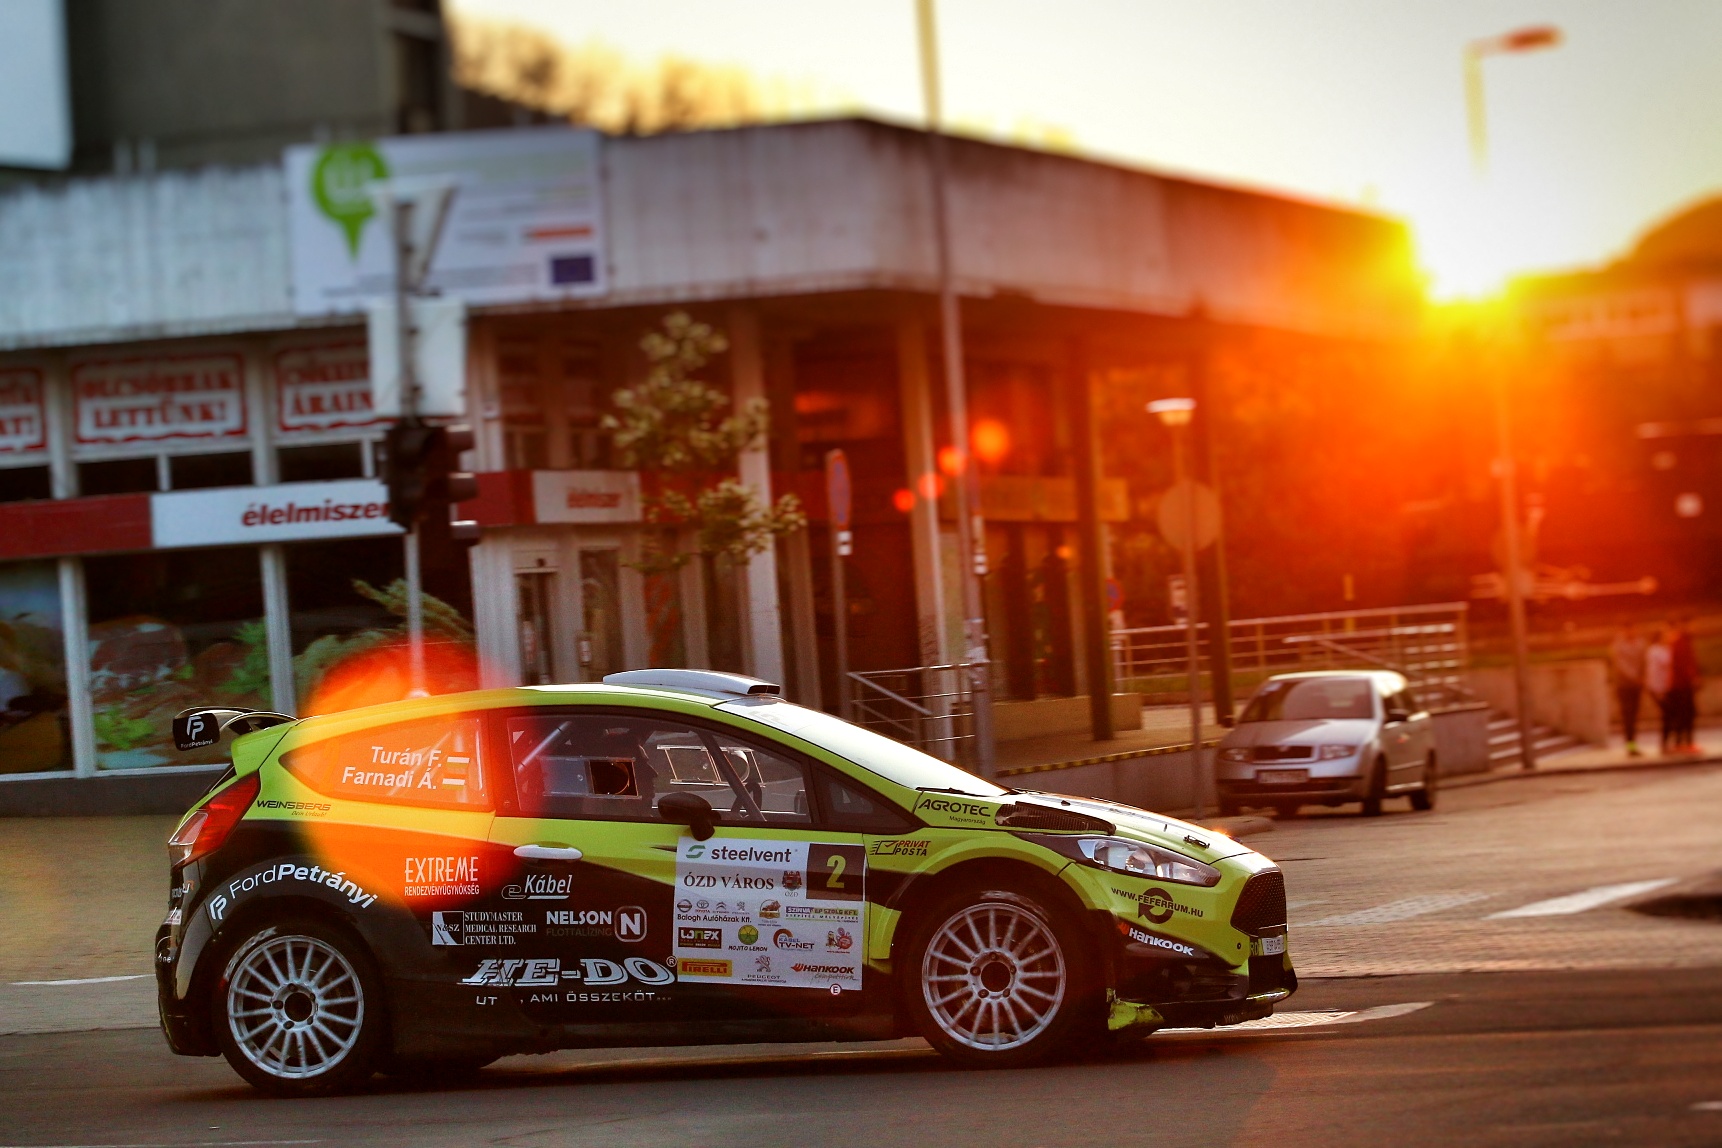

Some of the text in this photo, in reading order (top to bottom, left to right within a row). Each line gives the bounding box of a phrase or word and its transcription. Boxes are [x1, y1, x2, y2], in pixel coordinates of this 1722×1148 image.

[371, 745, 442, 768] Turán F.
[341, 766, 437, 790] Farnadi Á.
[918, 799, 991, 817] AGROTEC
[949, 815, 986, 825] Magyarország
[896, 840, 931, 848] PRIVAT
[711, 845, 792, 862] steelvent
[894, 848, 927, 856] POSTA
[404, 856, 479, 883] EXTREME
[826, 854, 847, 889] 2
[229, 863, 378, 909] FordPetrányi
[683, 872, 775, 891] ÓZD VÁROS
[1111, 886, 1204, 918] WWW.FEFERRUM.HU
[464, 911, 523, 922] STUDYMASTER
[546, 910, 612, 925] NELSON
[677, 914, 701, 923] Balogh
[464, 924, 537, 933] MEDICAL RESEARCH
[464, 935, 516, 945] CENTER LTD.
[779, 942, 815, 950] TV-NET
[456, 957, 676, 986] HE-DO
[682, 962, 727, 973] PIRELLI
[530, 993, 558, 1003] AMI
